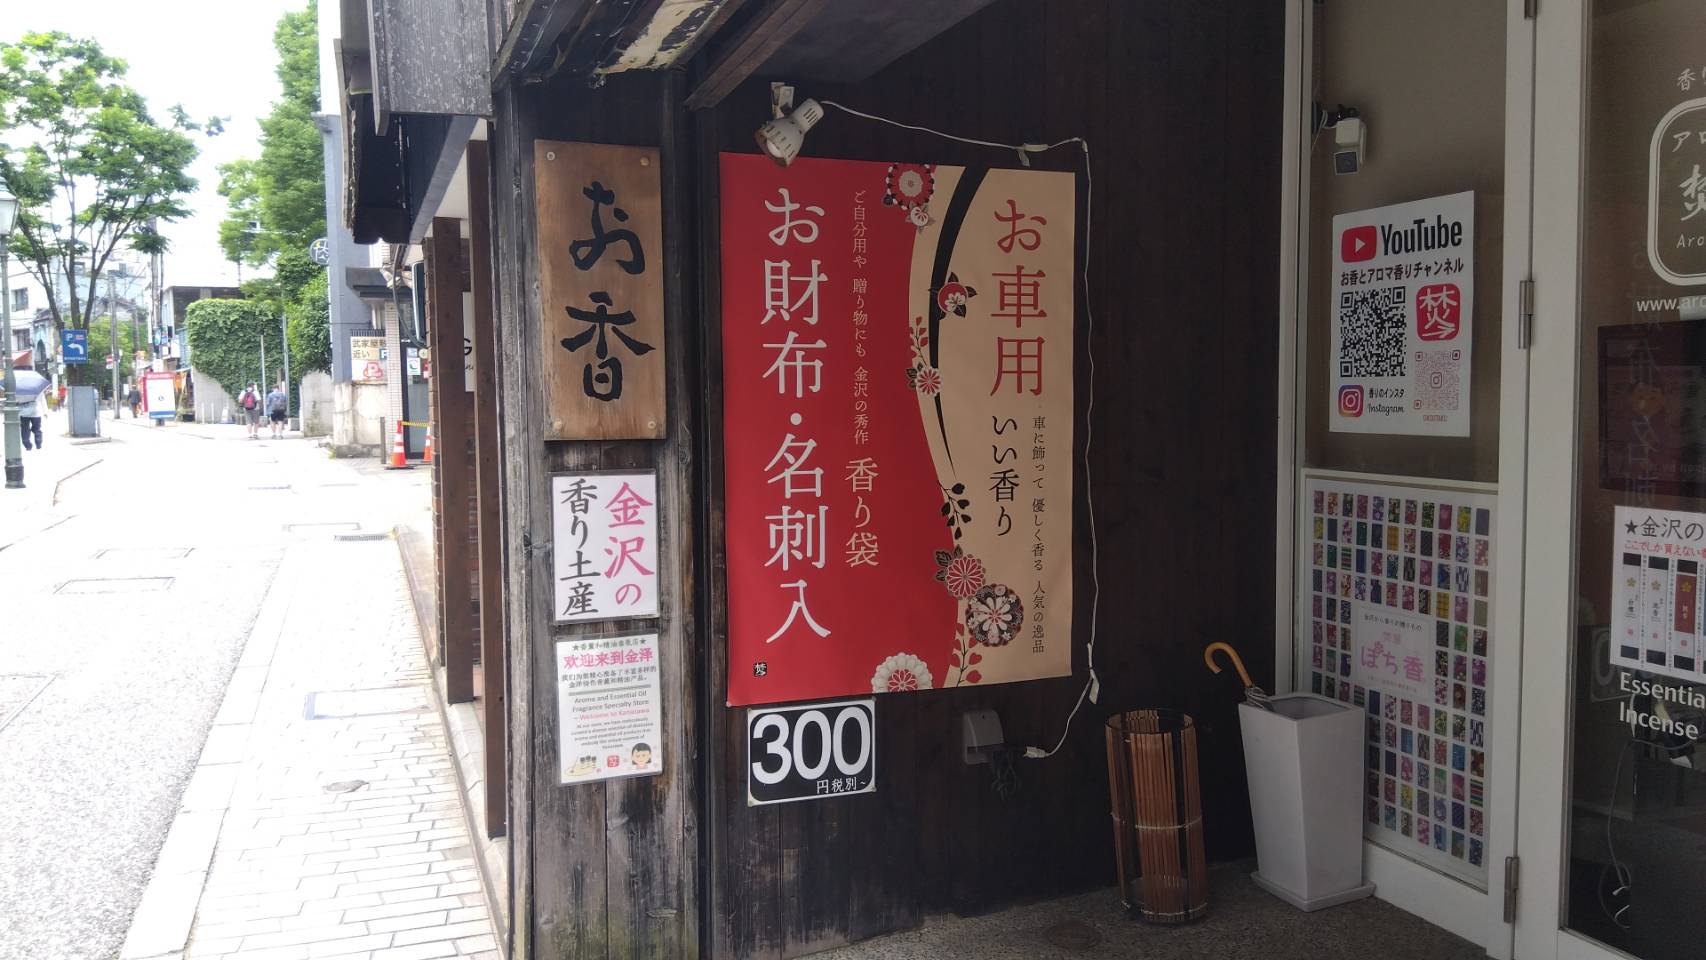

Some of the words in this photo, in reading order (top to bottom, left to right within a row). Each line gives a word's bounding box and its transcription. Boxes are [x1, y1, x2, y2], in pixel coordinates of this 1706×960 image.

[852, 191, 868, 268] ご自分用や
[1381, 214, 1462, 256] YouTube
[561, 181, 656, 401] お香
[990, 199, 1047, 397] お車用
[1340, 257, 1465, 286] お香とアロマ香りチャンネル
[853, 278, 868, 357] 贈り物にも
[761, 188, 831, 643] お財布・名刺入
[854, 366, 869, 445] 金沢の秀作
[1367, 403, 1405, 416] Instagram
[845, 457, 879, 567] 香り袋
[989, 416, 1020, 536] いい香り
[560, 478, 601, 615] 香り土産
[604, 481, 655, 606] 金沢の
[1361, 641, 1424, 682] ぽち香
[1619, 672, 1706, 709] Essentia
[752, 706, 871, 784] 300
[1619, 701, 1699, 740] Incense
